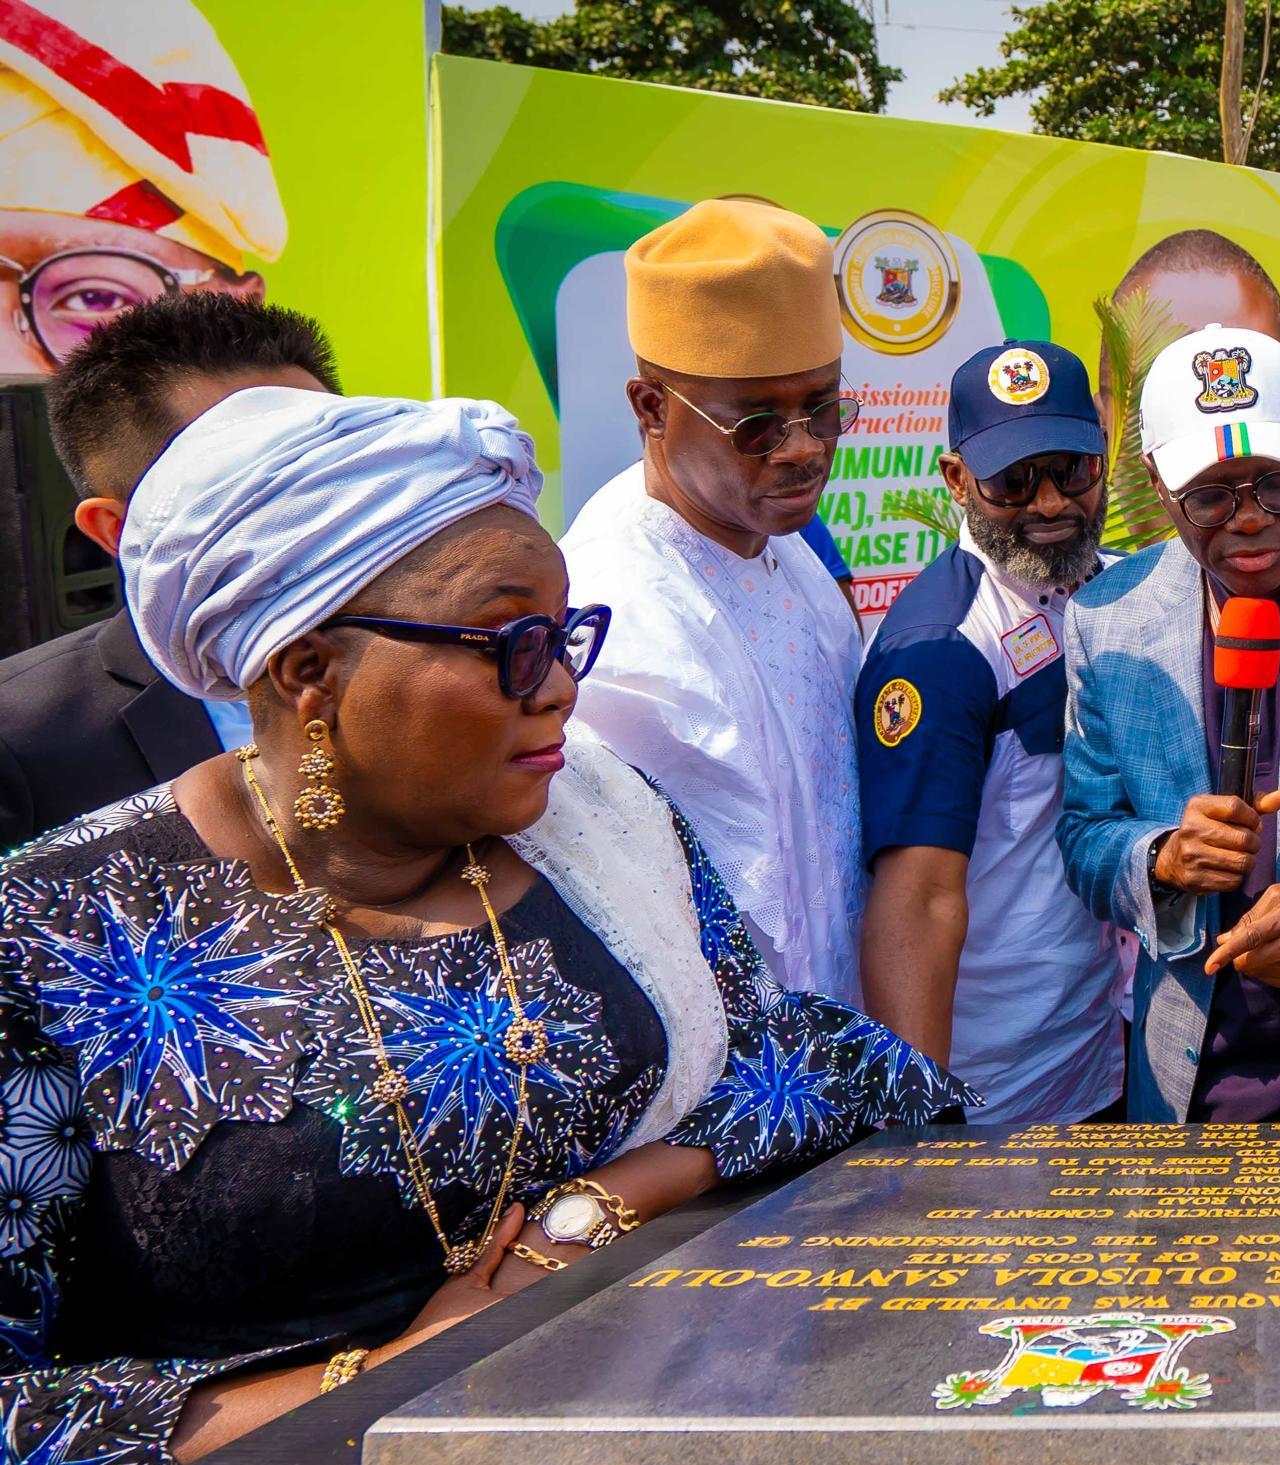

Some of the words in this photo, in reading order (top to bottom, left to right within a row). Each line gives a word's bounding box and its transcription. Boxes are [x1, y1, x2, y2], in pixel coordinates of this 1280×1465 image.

[852, 410, 943, 434] ruction
[828, 445, 924, 480] UMUNI
[834, 532, 909, 568] HASE
[460, 633, 489, 641] PRADA
[844, 1158, 908, 1166] STOP
[914, 1158, 961, 1166] BUS
[1163, 1157, 1233, 1165] IREDE
[1060, 1168, 1108, 1176] LTD
[1113, 1167, 1229, 1175] COMPANY
[1049, 1188, 1101, 1196] LTD
[1158, 1197, 1228, 1205] ROAD
[926, 1210, 980, 1218] LTD
[982, 1209, 1114, 1218] COMPANY
[738, 1235, 795, 1247] OF
[801, 1234, 1078, 1246] COMMISSIONING
[1092, 1235, 1156, 1246] THE
[1173, 1234, 1218, 1245] OF
[903, 1252, 1011, 1264] STATE
[1024, 1252, 1141, 1264] LAGOS
[1153, 1251, 1199, 1263] OF
[628, 1268, 968, 1287] SANWO-OLU
[994, 1266, 1236, 1286] OLUSOLA
[808, 1297, 871, 1311] BY
[881, 1296, 1071, 1310] UNVEILED
[1093, 1296, 1168, 1309] WAS
